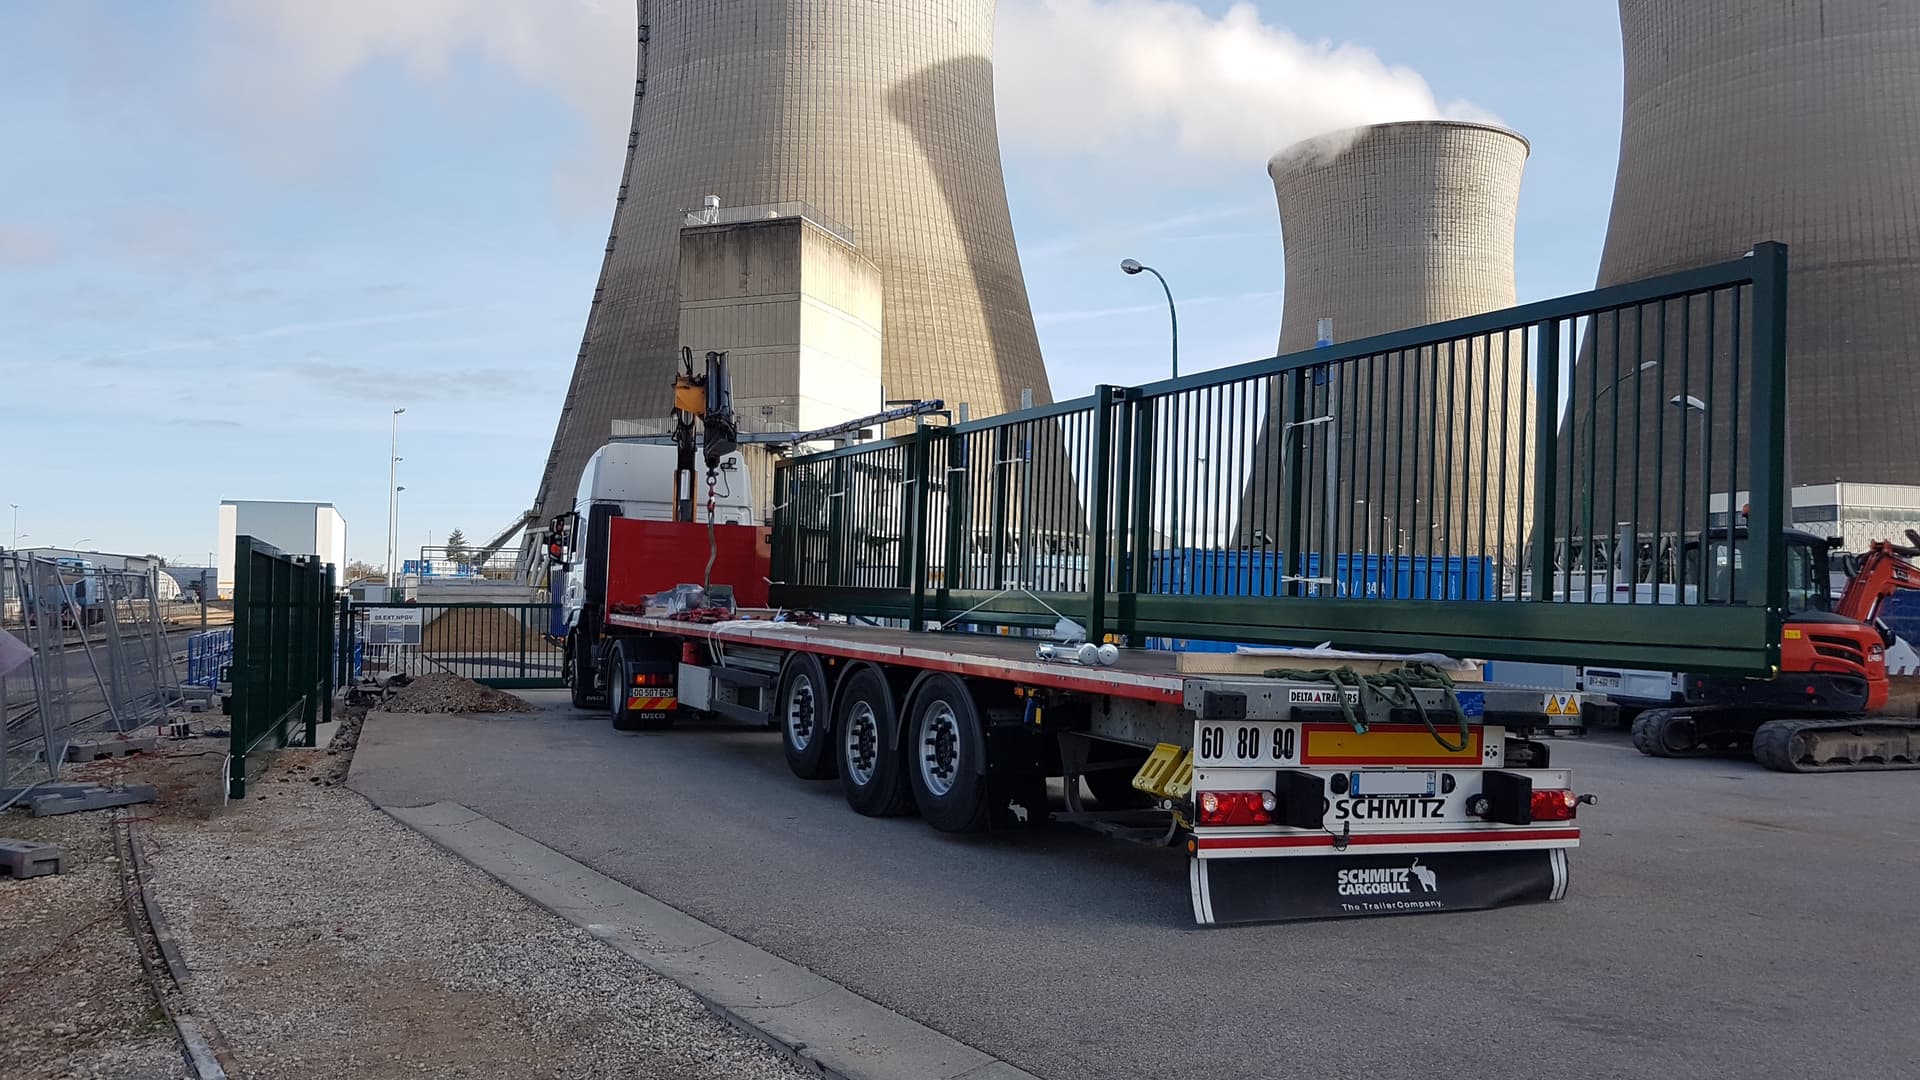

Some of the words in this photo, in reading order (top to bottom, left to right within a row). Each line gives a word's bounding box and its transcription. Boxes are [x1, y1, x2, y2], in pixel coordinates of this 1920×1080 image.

[1291, 691, 1313, 702] DELTA
[1322, 693, 1357, 704] TRAIRS
[1201, 726, 1224, 759] 60
[1237, 726, 1260, 759] 80
[1272, 728, 1295, 760] 90
[1335, 799, 1446, 819] SCHMITZ
[1338, 868, 1409, 884] SCHMITZ
[1338, 882, 1410, 895] CARGOBULL
[1341, 903, 1360, 911] The
